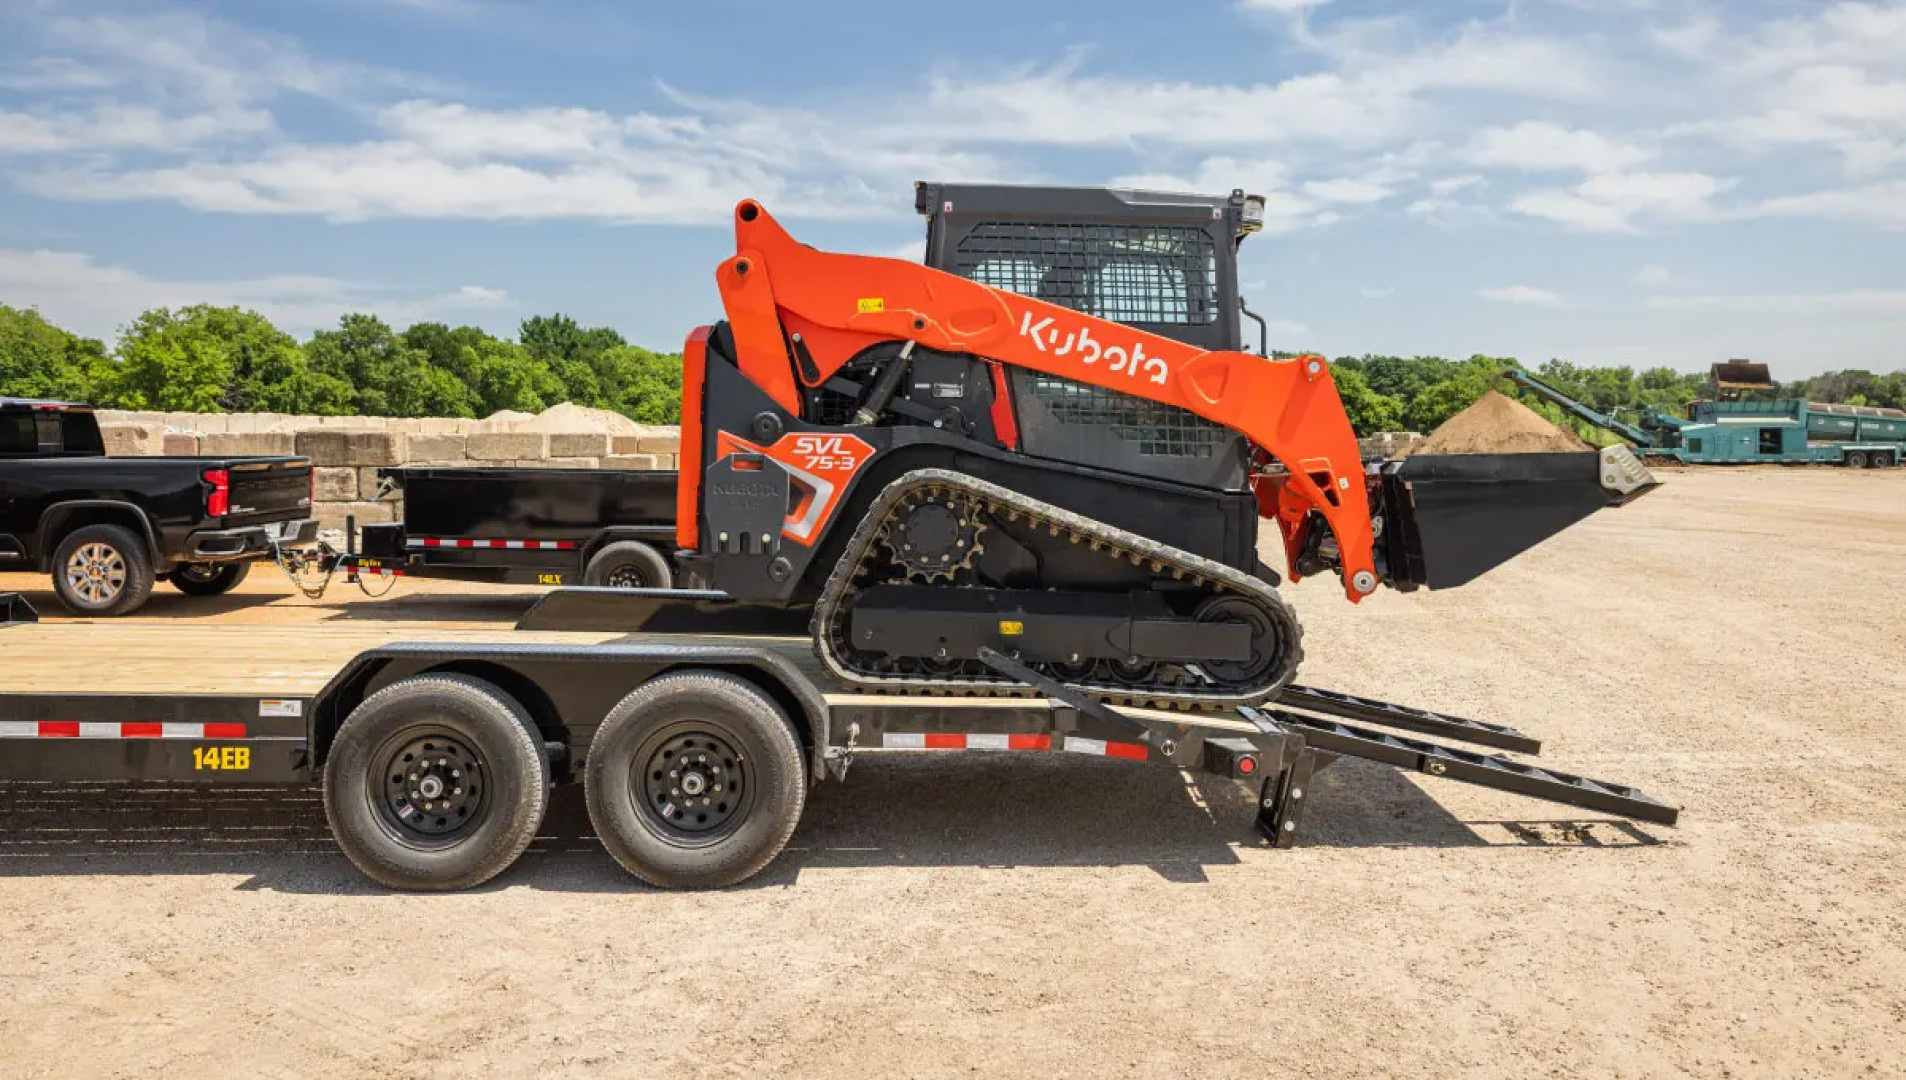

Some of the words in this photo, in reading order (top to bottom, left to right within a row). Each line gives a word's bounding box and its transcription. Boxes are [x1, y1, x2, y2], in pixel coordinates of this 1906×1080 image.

[1019, 311, 1168, 385] Kubota
[793, 437, 852, 455] SVL
[804, 456, 855, 471] 75-3
[193, 747, 250, 770] 14EB
